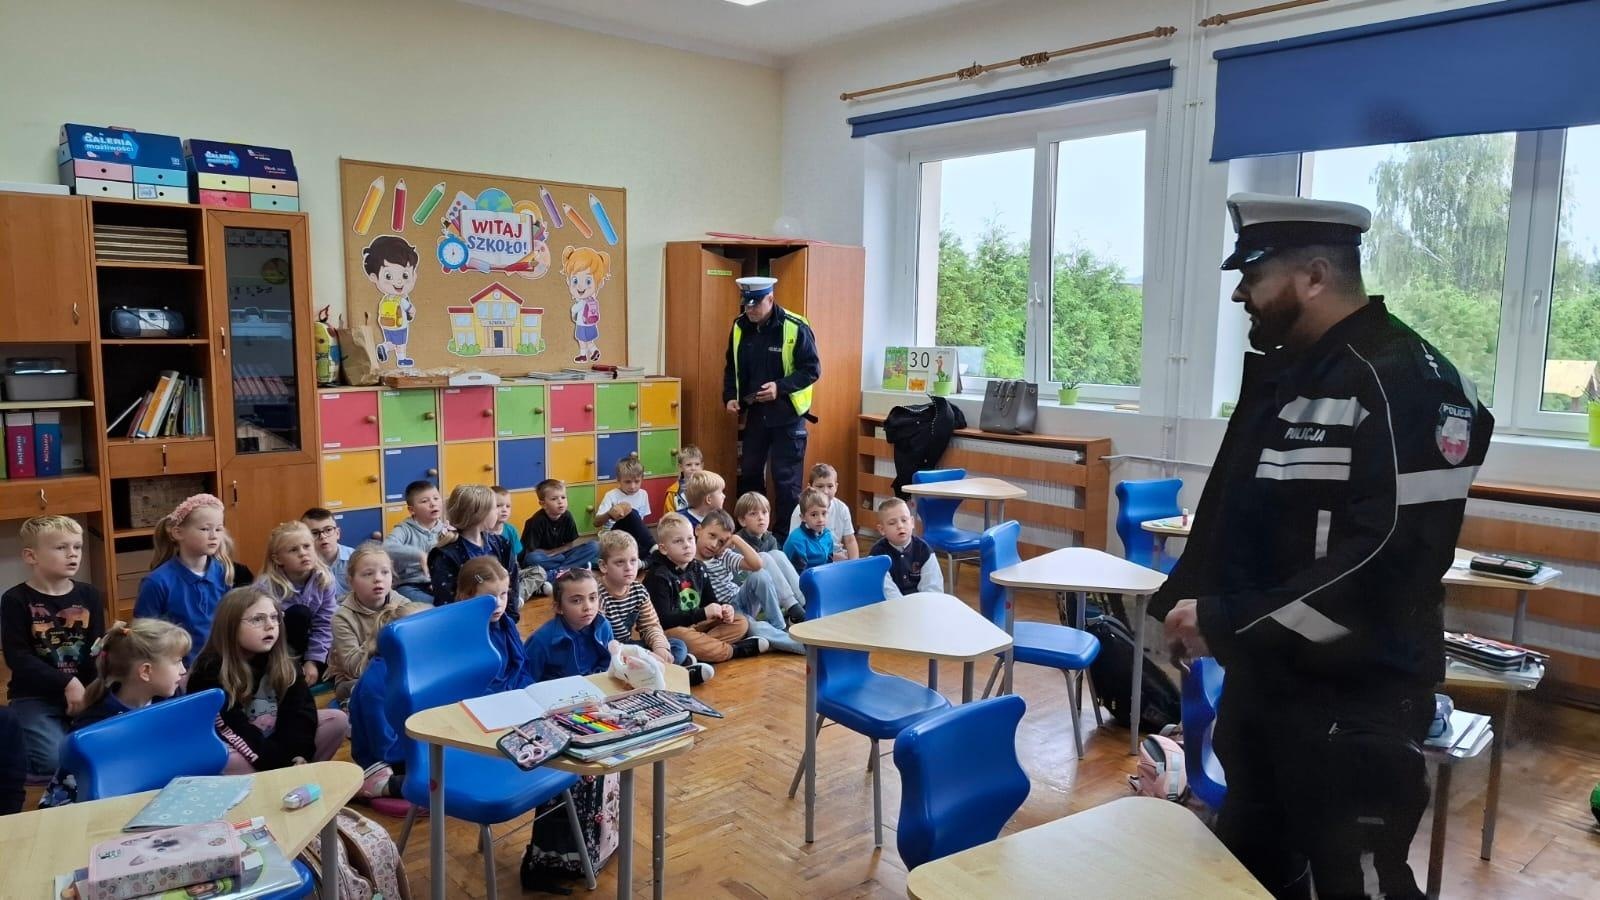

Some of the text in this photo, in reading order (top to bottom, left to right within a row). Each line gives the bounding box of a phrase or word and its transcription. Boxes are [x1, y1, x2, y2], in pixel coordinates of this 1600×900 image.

[84, 132, 133, 146] GALERIA
[471, 219, 523, 239] WITAJ
[467, 235, 528, 255] SZKOŁO!
[909, 351, 930, 368] 30
[1443, 404, 1471, 418] POLICJA
[1284, 427, 1326, 442] POLICJA
